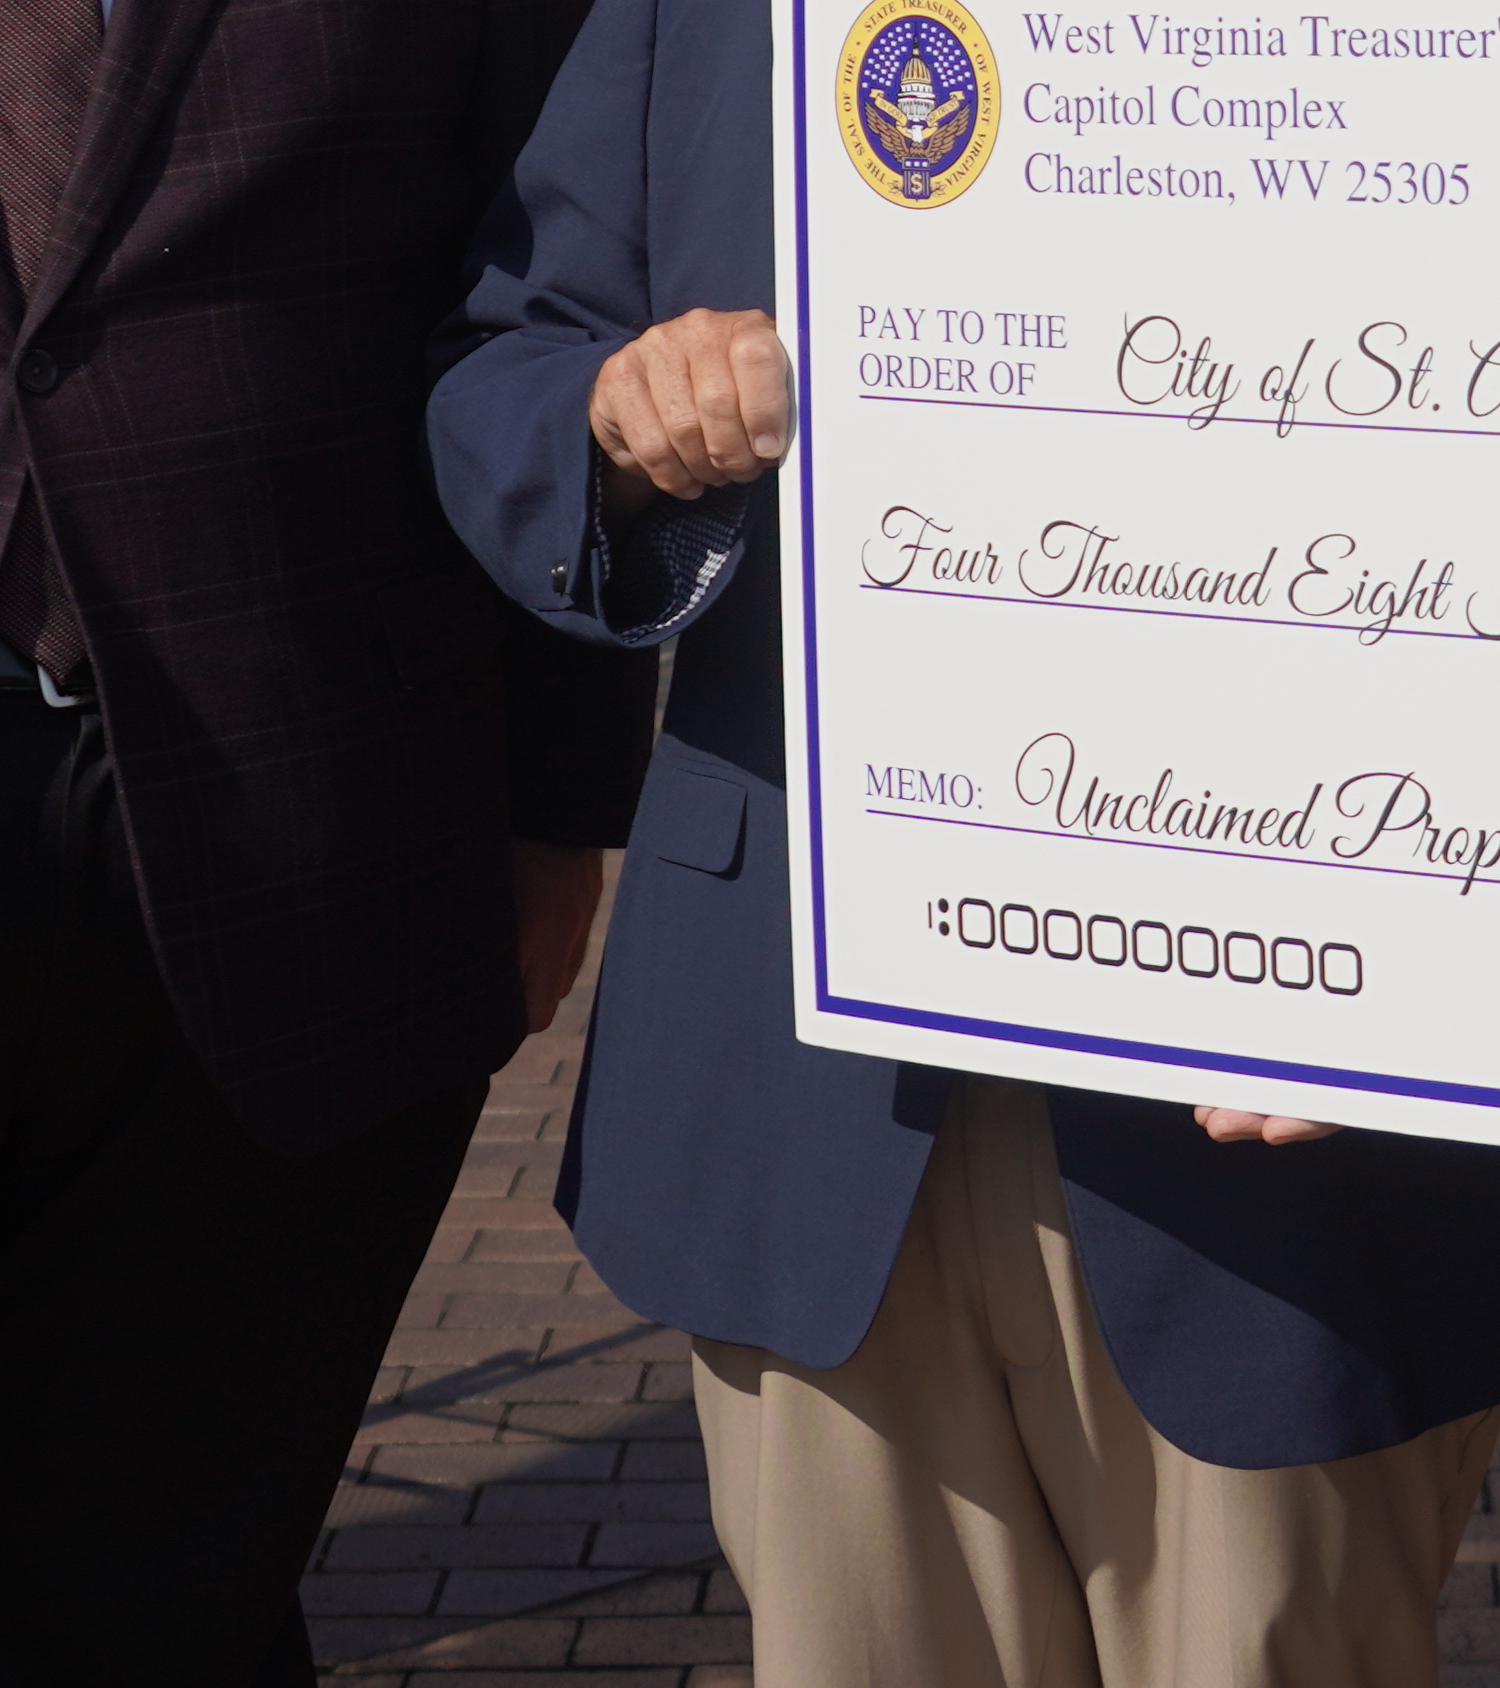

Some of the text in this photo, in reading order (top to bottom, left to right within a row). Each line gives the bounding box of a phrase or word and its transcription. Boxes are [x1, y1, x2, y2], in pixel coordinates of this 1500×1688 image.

[864, 1, 898, 33] STATE
[1022, 13, 1115, 55] West
[1128, 14, 1288, 69] Virginia
[843, 53, 887, 185] THE SEAL OF THE
[945, 53, 993, 187] OF WEST VIRGINIA
[1023, 82, 1348, 138] Capitol Complex
[1024, 152, 1470, 206] Charleston, WV 25305
[858, 305, 1068, 349] PAY TO THE
[858, 353, 1036, 396] ORDER OF
[1116, 312, 1241, 430] City
[1259, 338, 1317, 438] of
[1325, 321, 1443, 415] St.
[861, 505, 1003, 587] Four
[1018, 519, 1279, 607] Thousand
[1287, 533, 1454, 644] Eight
[865, 763, 983, 809] MEMO:
[1015, 732, 1323, 849] Unclaimed
